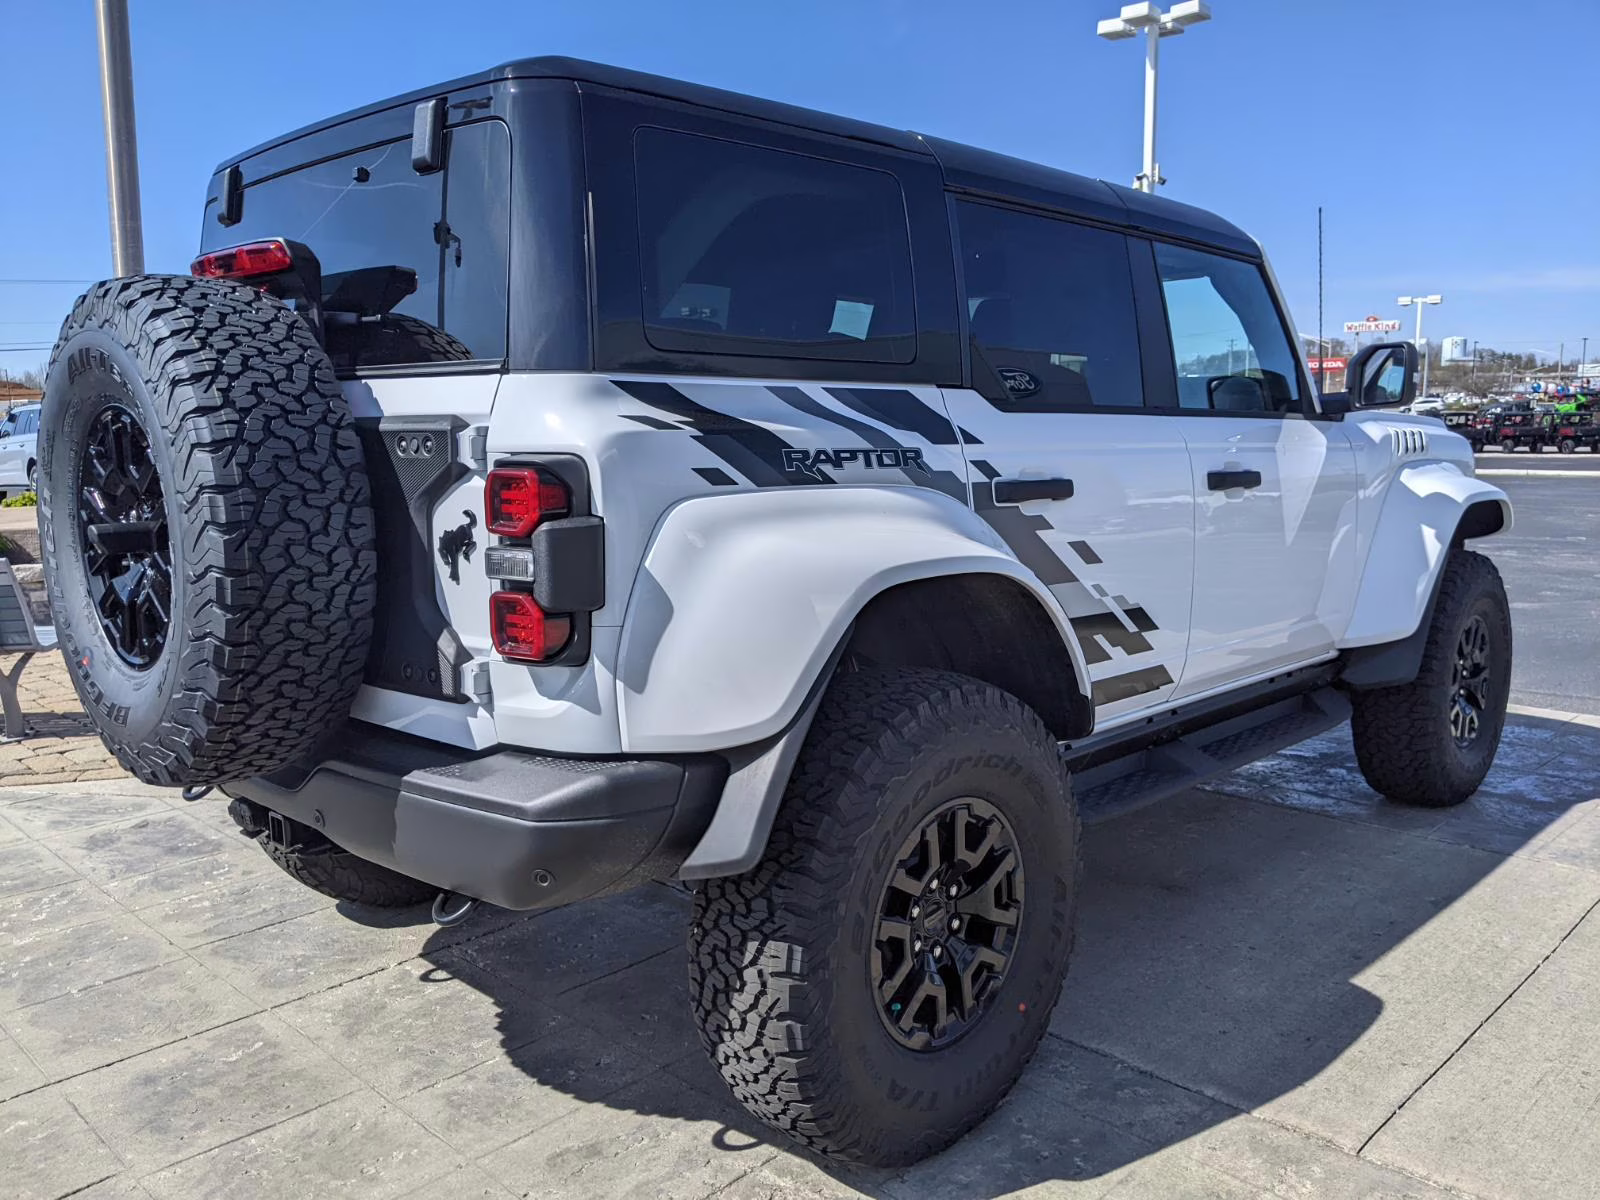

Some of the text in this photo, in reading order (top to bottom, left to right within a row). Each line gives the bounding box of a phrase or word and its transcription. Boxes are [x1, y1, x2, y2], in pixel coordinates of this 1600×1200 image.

[1346, 321, 1397, 331] Waffle King
[782, 447, 931, 481] RAPTOR
